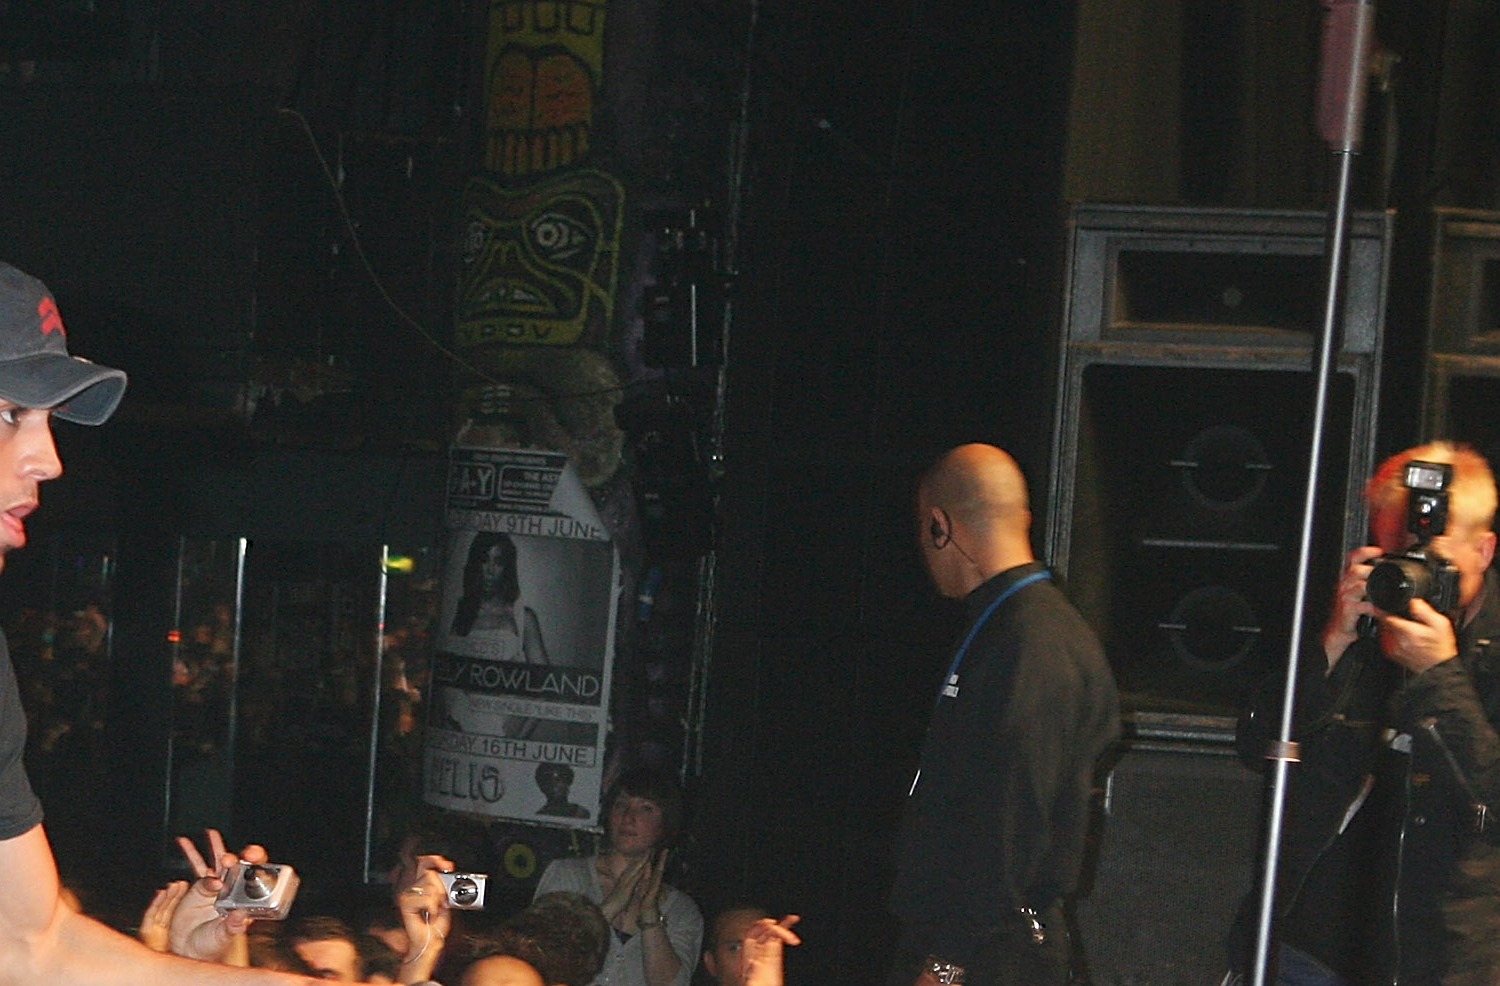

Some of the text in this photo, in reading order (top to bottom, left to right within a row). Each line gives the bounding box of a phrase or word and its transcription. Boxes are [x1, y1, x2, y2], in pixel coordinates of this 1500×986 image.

[506, 513, 542, 534] 9TH
[548, 517, 600, 539] JUNE
[470, 663, 600, 697] ROWLAND
[482, 738, 526, 758] 16TH
[532, 744, 588, 764] JUNE
